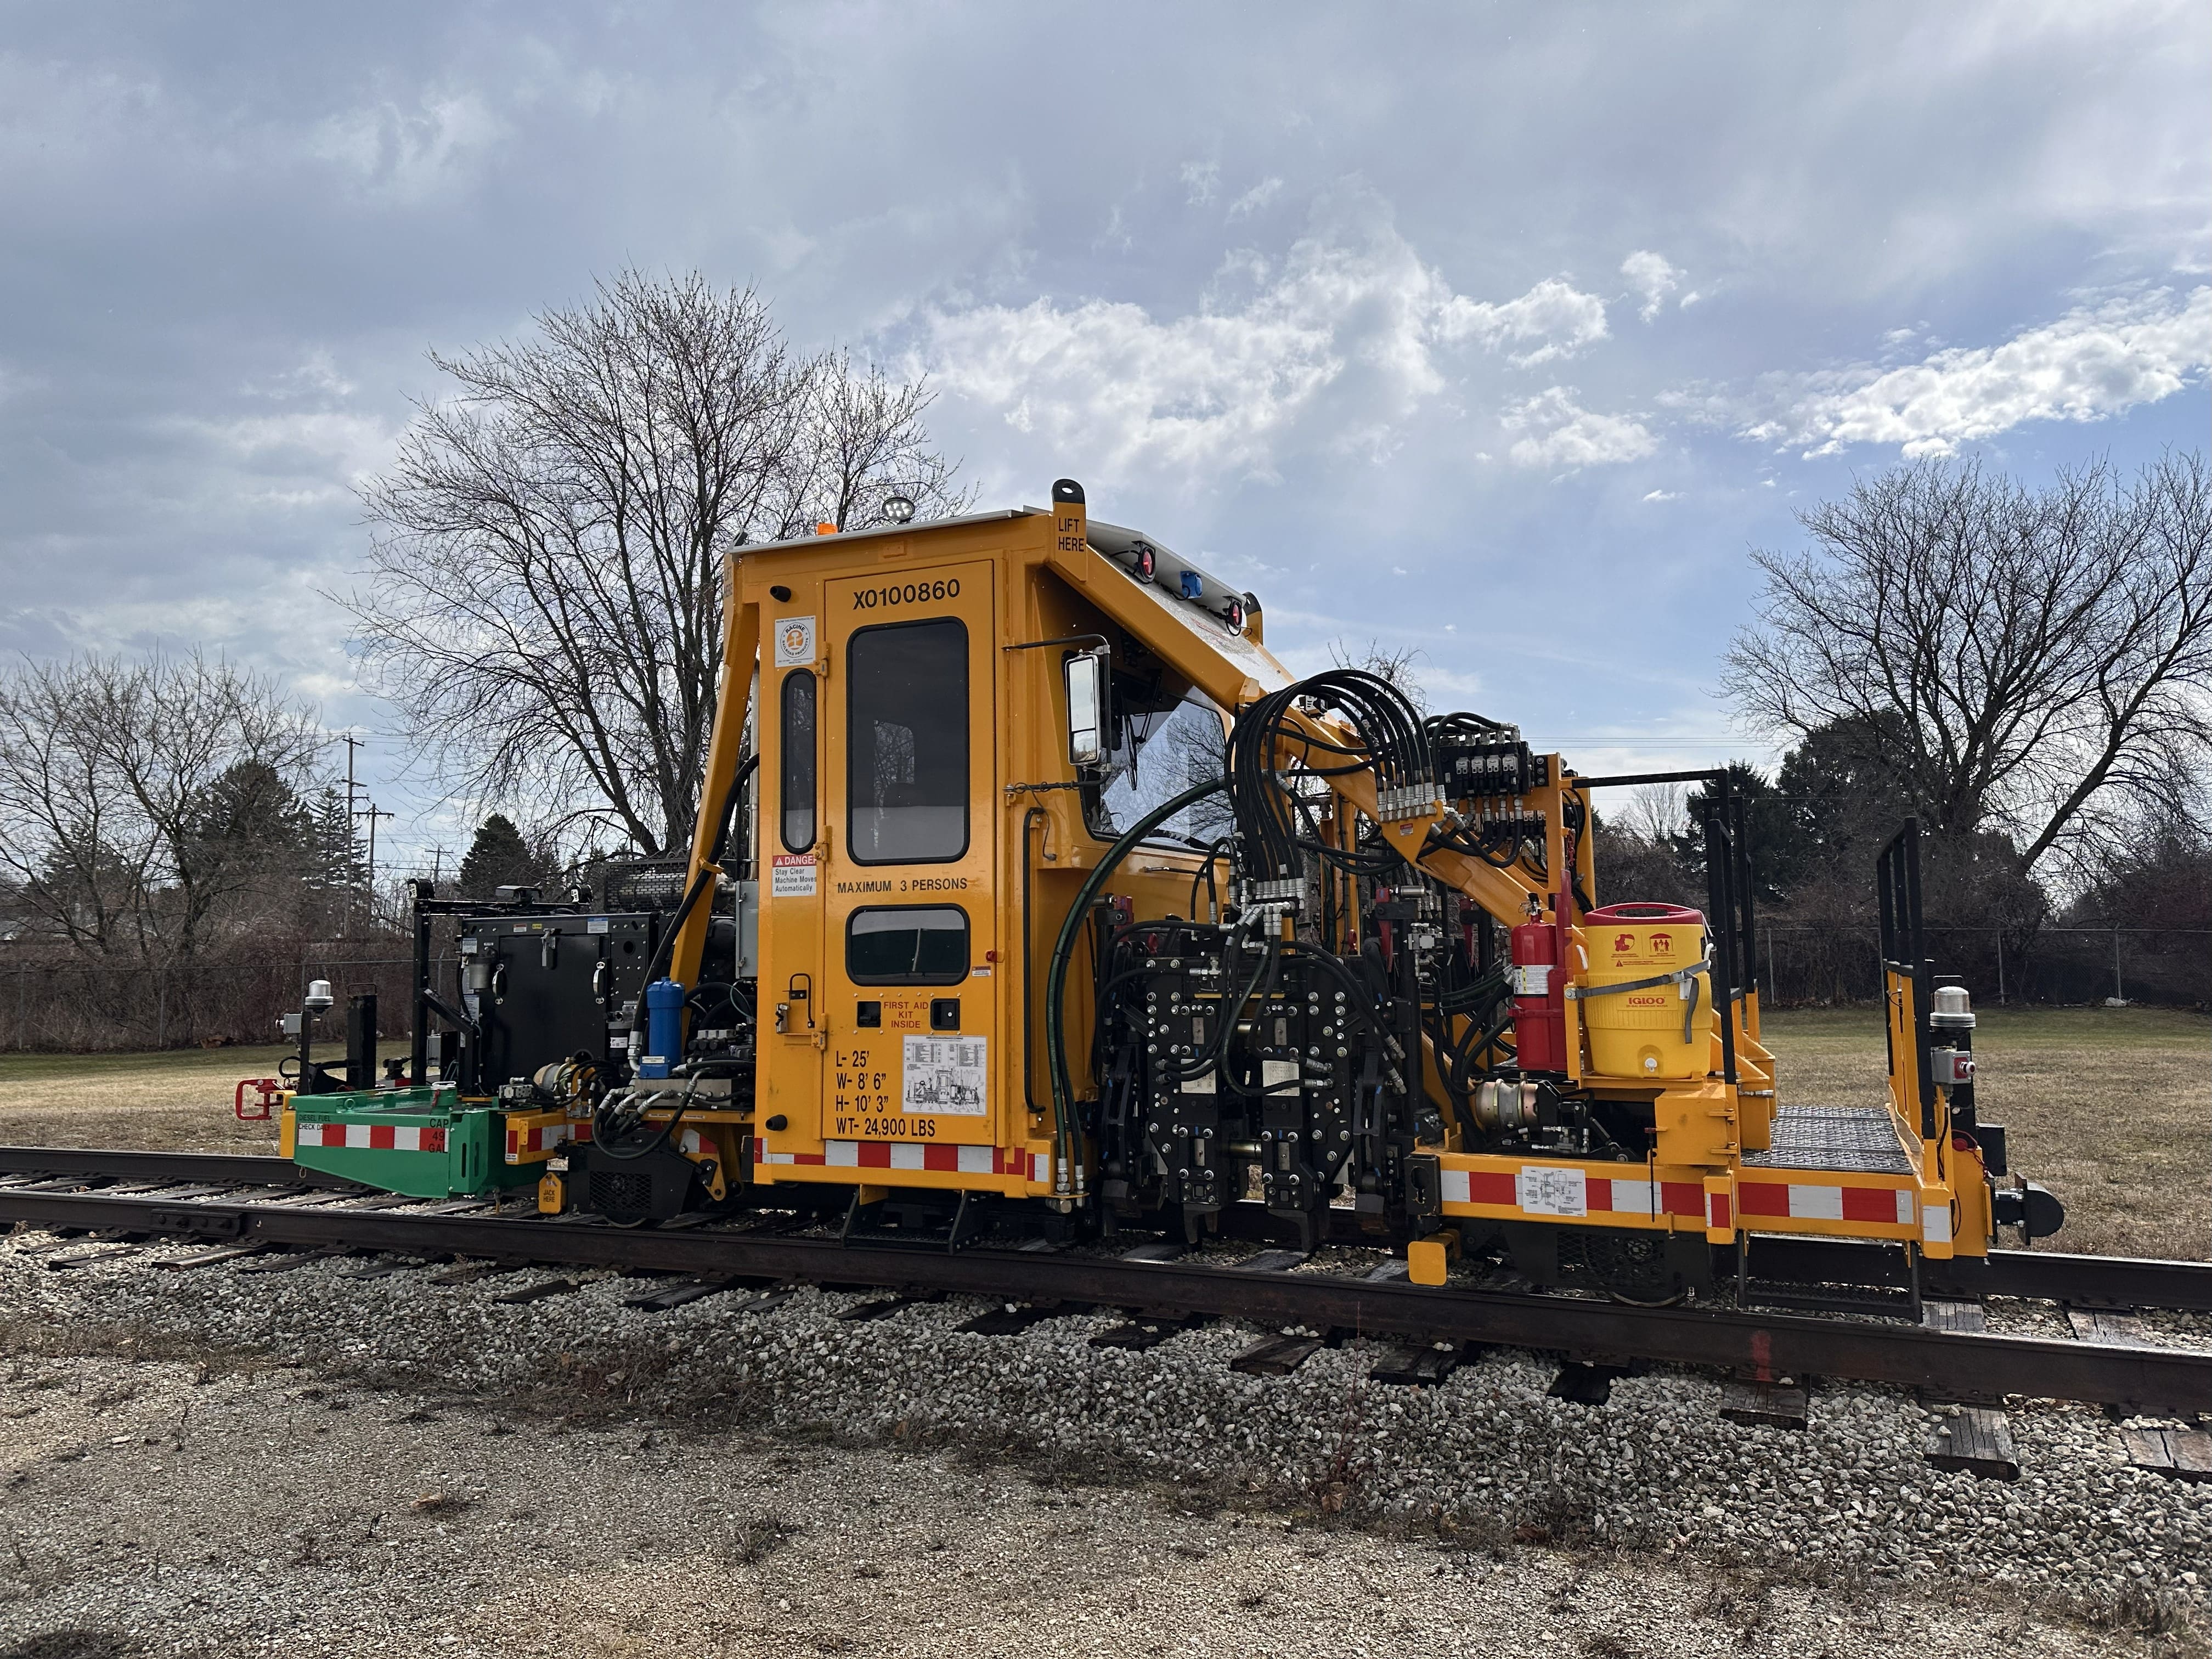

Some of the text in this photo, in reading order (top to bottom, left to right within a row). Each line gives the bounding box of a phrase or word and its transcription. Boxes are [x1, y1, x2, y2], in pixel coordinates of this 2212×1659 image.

[1058, 518, 1079, 533] LIFT
[1058, 536, 1085, 552] HERE
[853, 579, 960, 610] X0100860
[785, 624, 805, 634] RACINE
[838, 878, 968, 893] MAXIMUM 3 PERSONS
[836, 1051, 847, 1067] L-
[836, 1073, 853, 1090] W-
[836, 1095, 849, 1112] H-
[430, 1118, 449, 1128] CAP
[836, 1118, 936, 1139] WT- 24,900 LBS
[432, 1131, 445, 1141] 49
[428, 1143, 448, 1154] GAL
